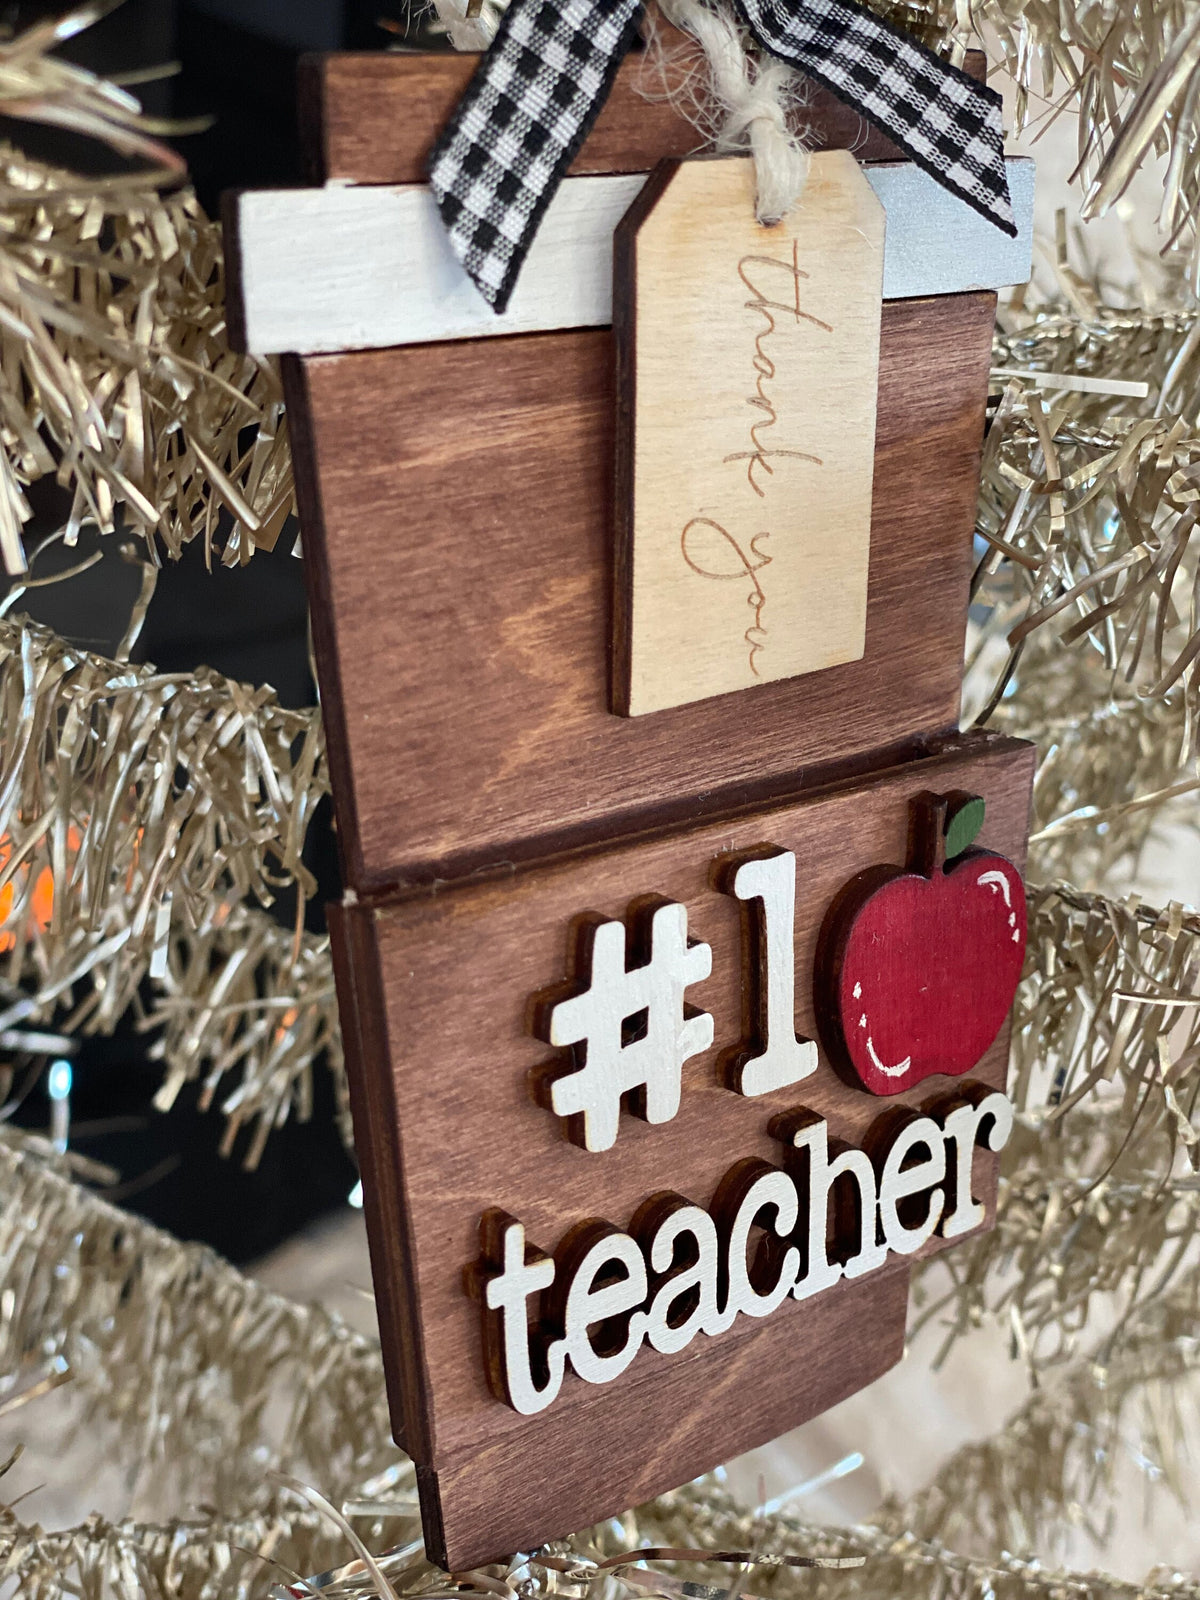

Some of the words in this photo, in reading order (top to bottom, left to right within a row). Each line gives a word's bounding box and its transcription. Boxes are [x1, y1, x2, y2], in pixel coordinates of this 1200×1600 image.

[722, 238, 834, 499] thank
[681, 517, 774, 677] you
[550, 850, 819, 1153] #1
[486, 1092, 1013, 1416] teacher
